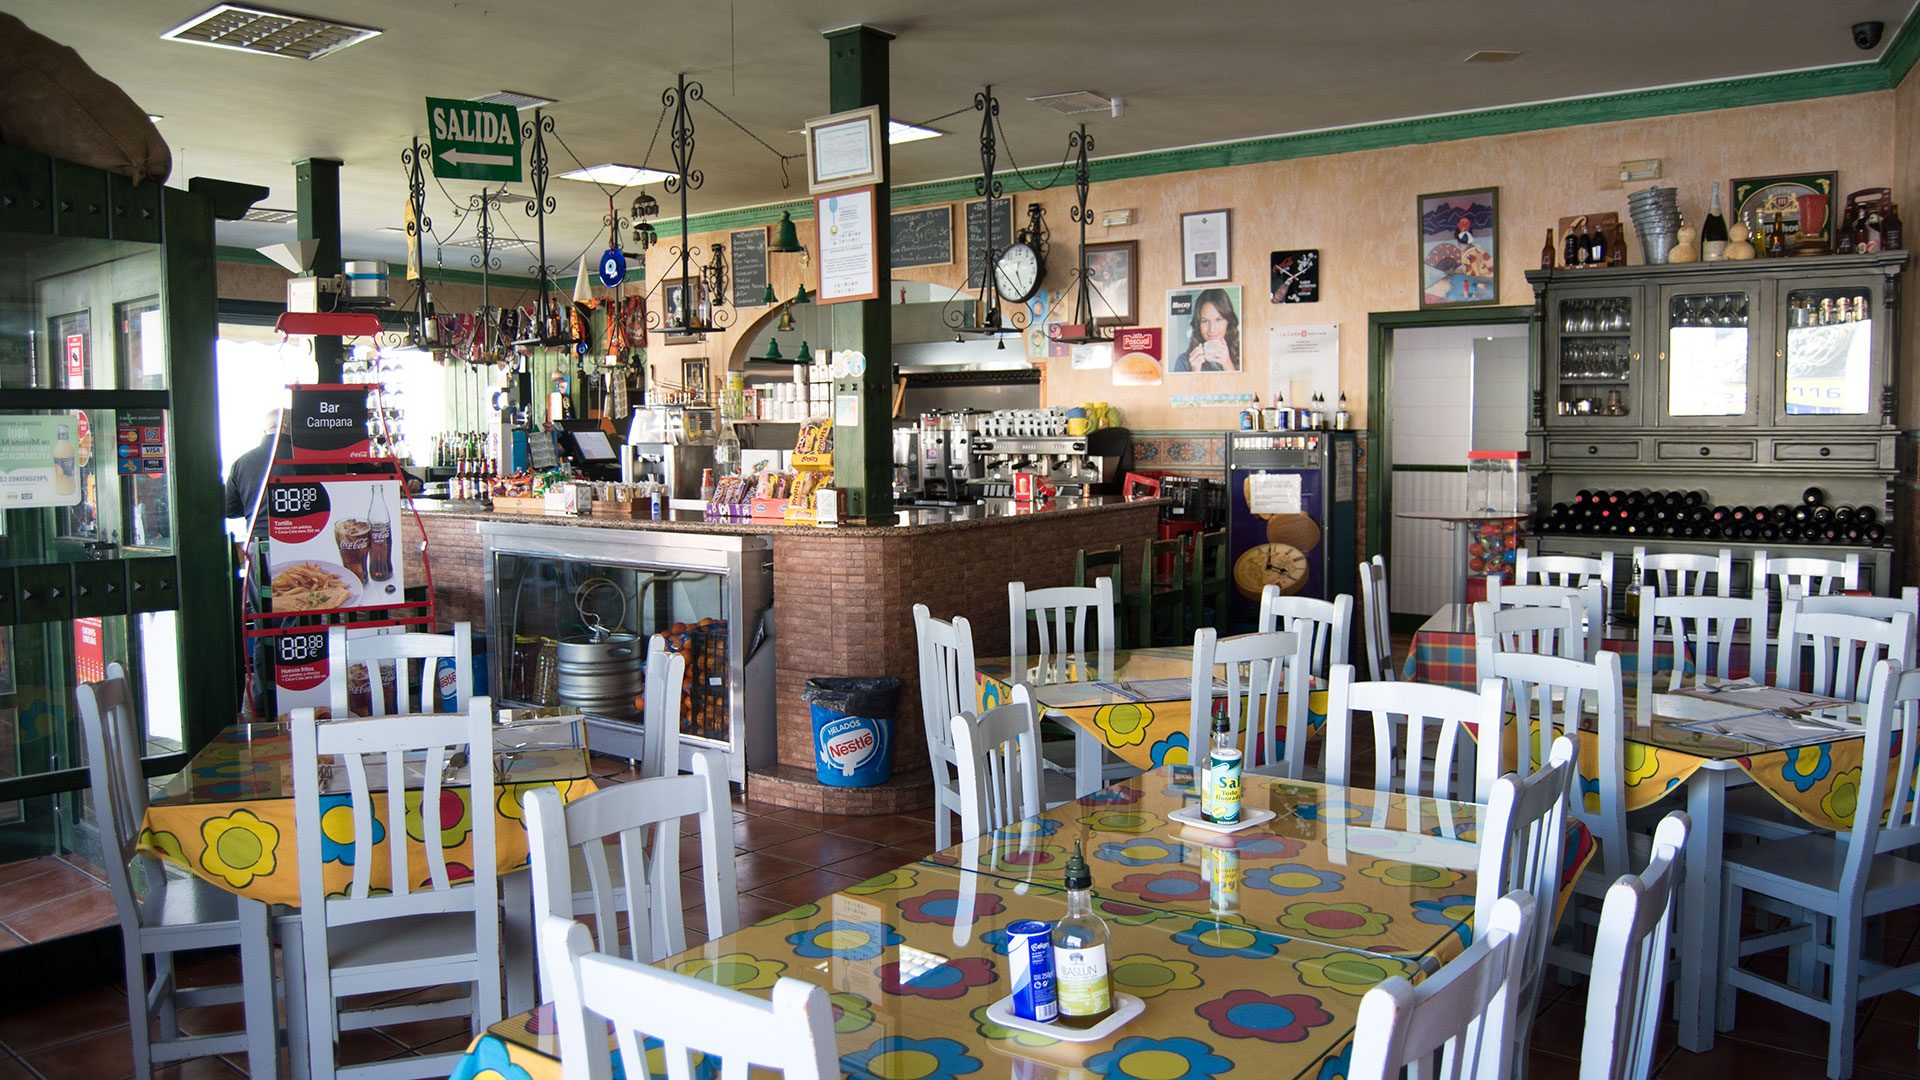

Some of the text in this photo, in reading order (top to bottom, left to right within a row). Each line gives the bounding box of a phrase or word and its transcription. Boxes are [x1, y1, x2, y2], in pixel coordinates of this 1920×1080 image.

[433, 107, 514, 145] SALIDA
[1124, 337, 1150, 345] Pascual
[320, 402, 340, 413] Bar
[307, 417, 353, 429] Campana
[828, 719, 861, 735] HELADOS
[829, 732, 873, 758] Nestlé
[1219, 774, 1240, 788] Sal
